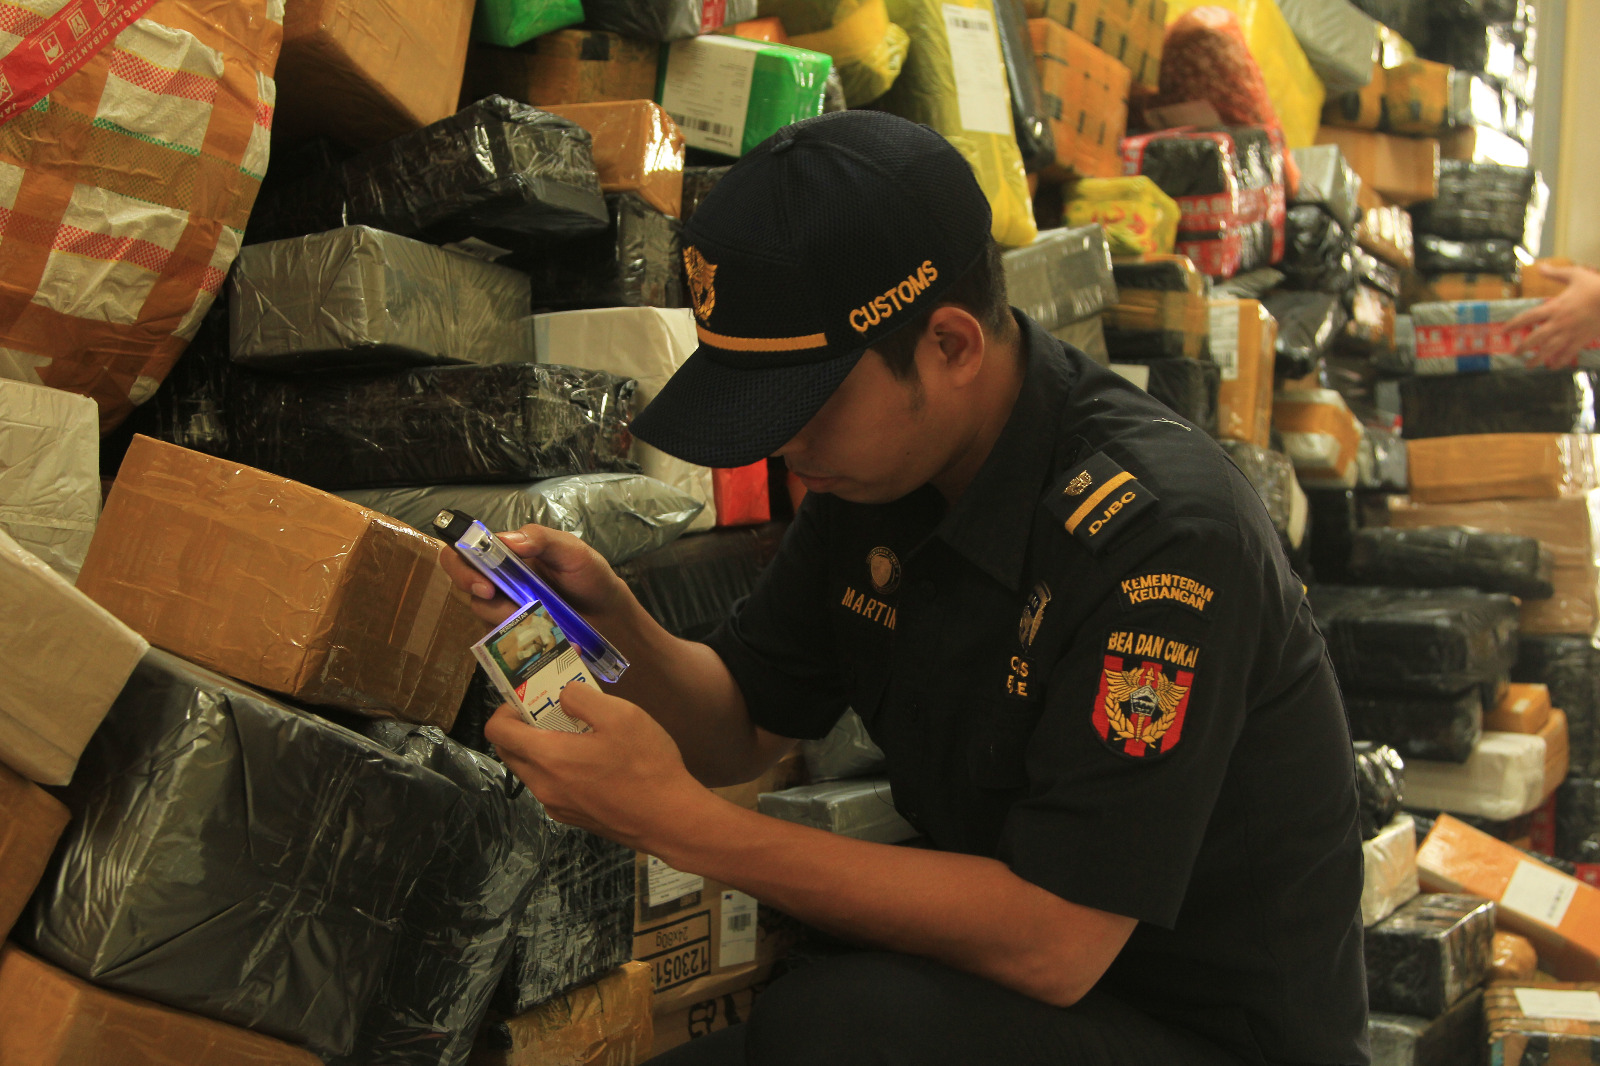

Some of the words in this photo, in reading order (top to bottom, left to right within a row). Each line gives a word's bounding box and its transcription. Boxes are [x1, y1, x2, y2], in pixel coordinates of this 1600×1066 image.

[849, 260, 938, 332] CUSTOMS
[1088, 491, 1136, 536] DJBC
[1121, 573, 1214, 602] KEMENTERIAN
[1129, 587, 1205, 611] KEUANGAN
[1107, 632, 1134, 655] BEA
[1136, 633, 1165, 659] DAN
[1164, 640, 1200, 668] CUKAI
[651, 946, 708, 987] 123051
